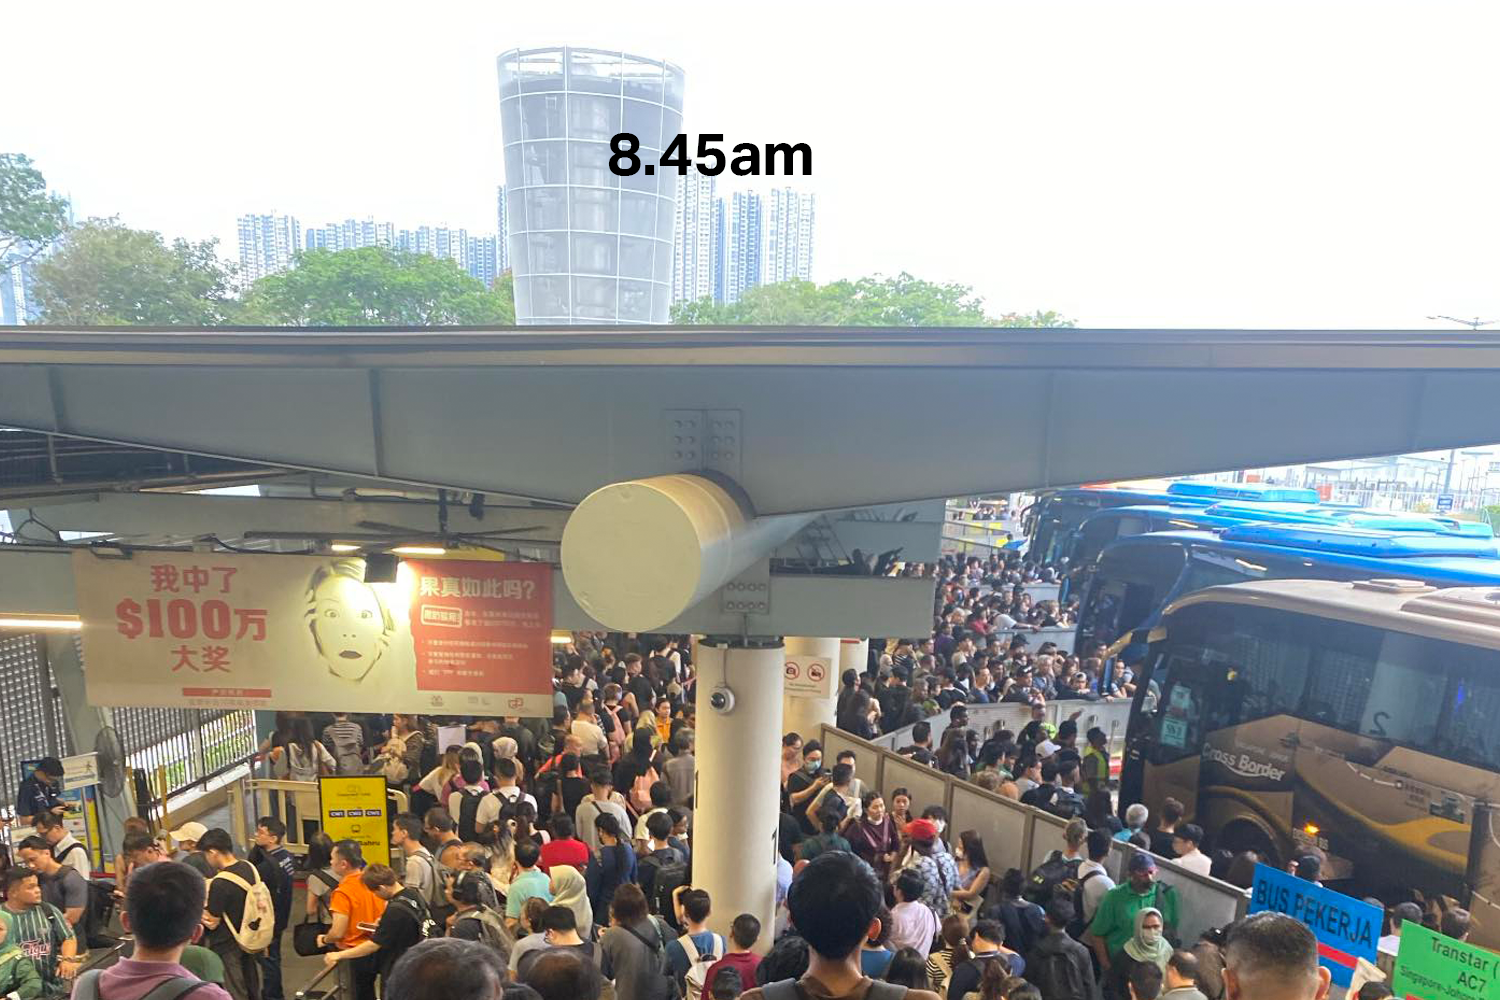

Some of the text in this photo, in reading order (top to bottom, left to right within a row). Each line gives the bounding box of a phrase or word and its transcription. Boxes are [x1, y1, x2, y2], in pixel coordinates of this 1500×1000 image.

[151, 564, 238, 593] 我中了
[419, 576, 535, 600] 果真如此吗?
[115, 598, 268, 641] $100万
[170, 644, 232, 673] 大奖
[1202, 742, 1237, 766] Cross
[1239, 754, 1286, 781] Border
[1256, 879, 1372, 949] BUS PEKERJA
[1431, 936, 1489, 970] Transtar
[1457, 971, 1487, 993] AC7
